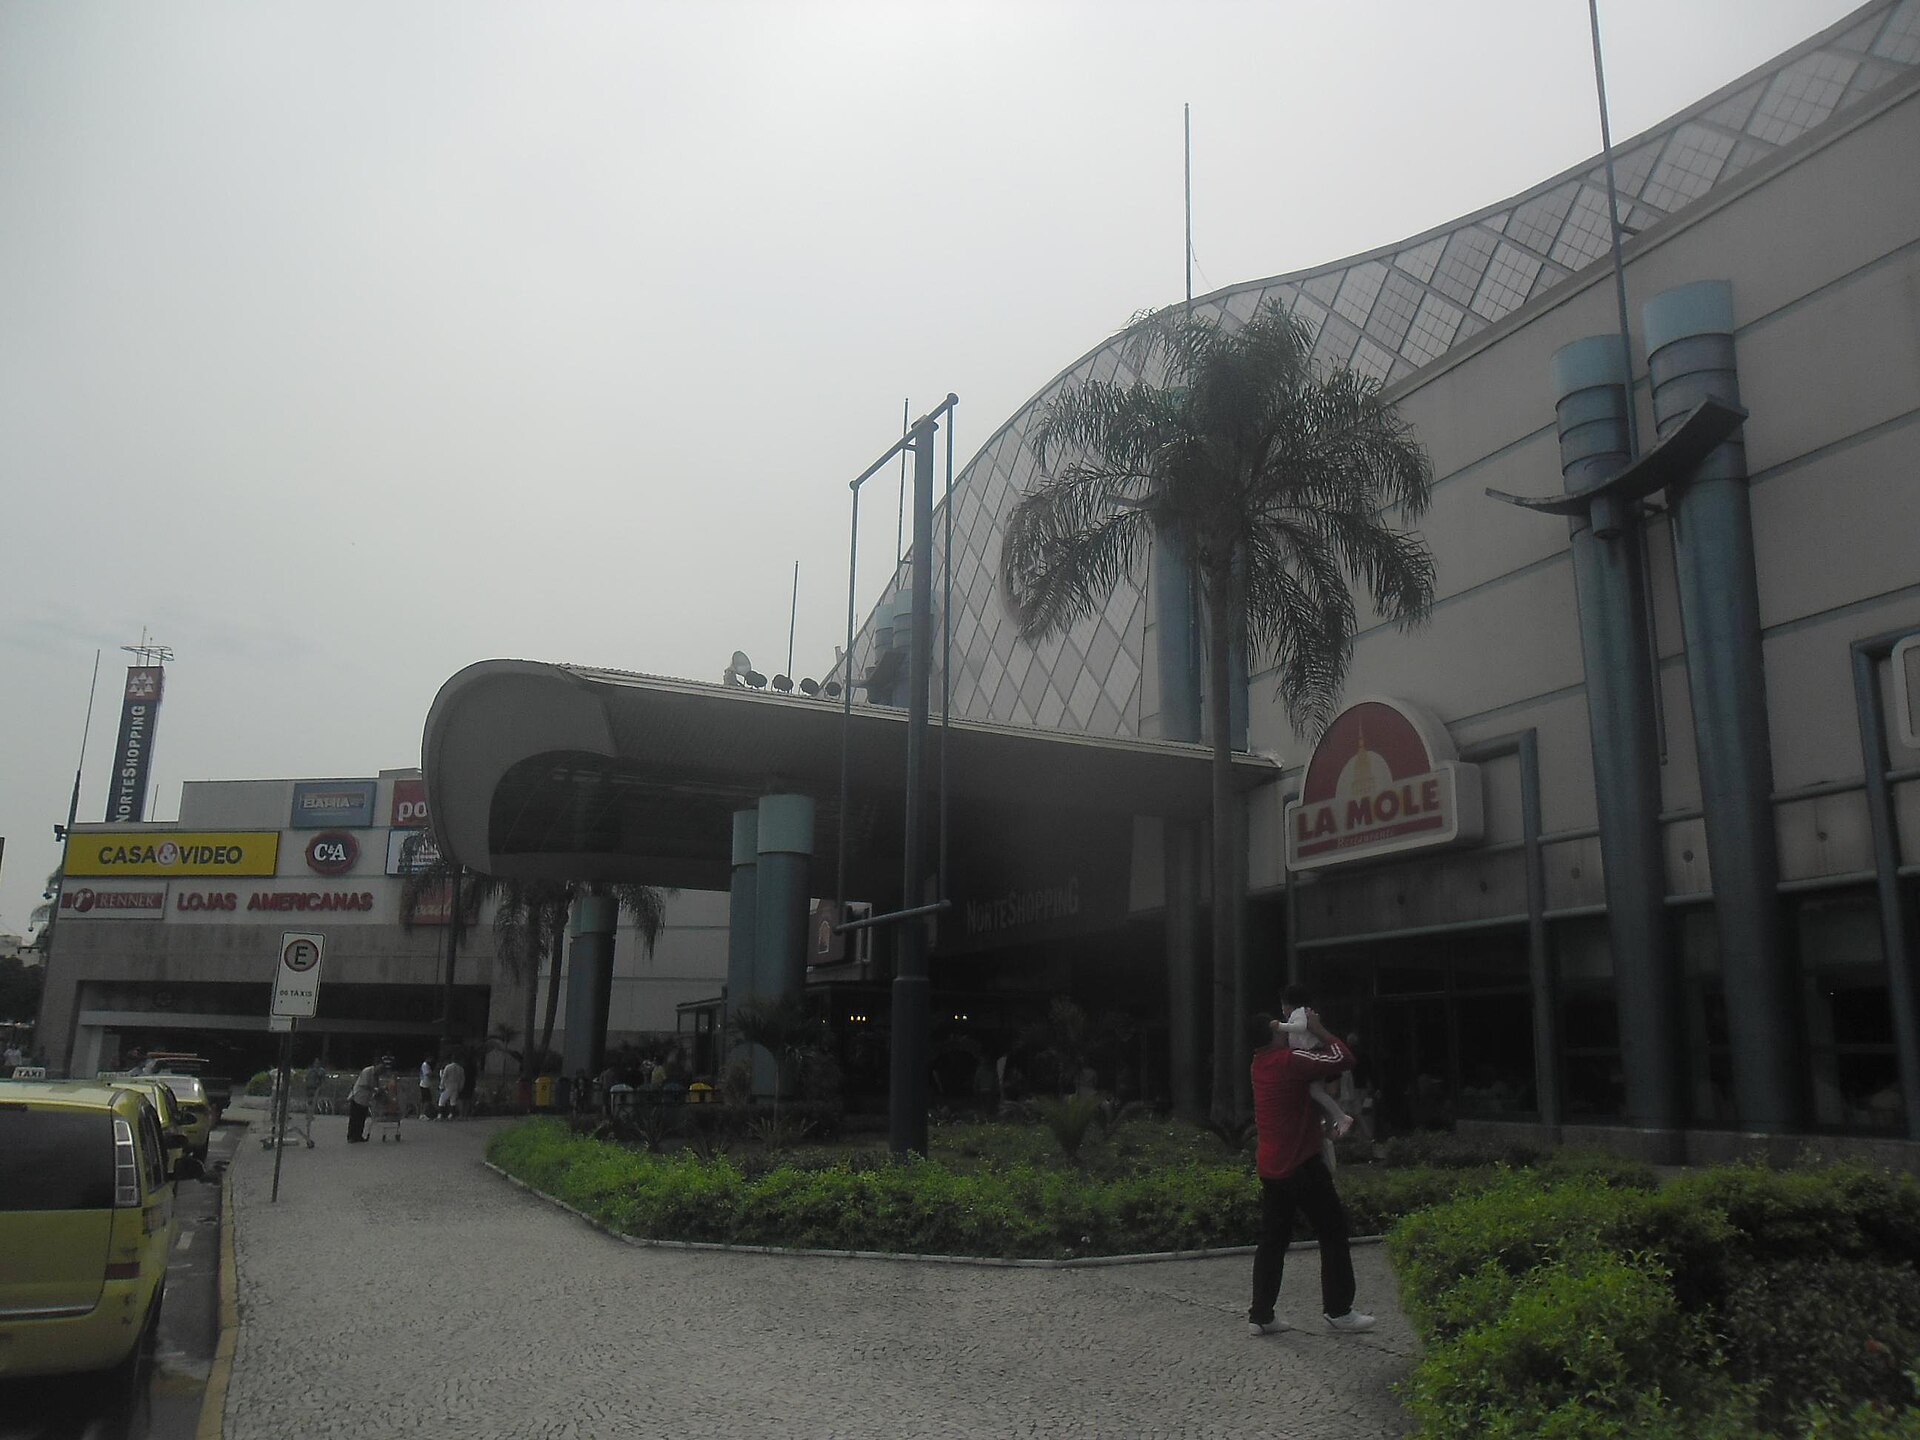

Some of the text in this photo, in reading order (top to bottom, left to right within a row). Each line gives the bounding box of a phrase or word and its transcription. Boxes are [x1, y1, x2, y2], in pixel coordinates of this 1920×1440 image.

[1297, 779, 1440, 841] LA MOLE
[313, 842, 347, 862] C&A
[99, 894, 155, 907] RENNER
[177, 891, 374, 912] LOJAS AMERICANAS
[294, 945, 308, 965] E
[18, 1070, 42, 1078] TAXI
